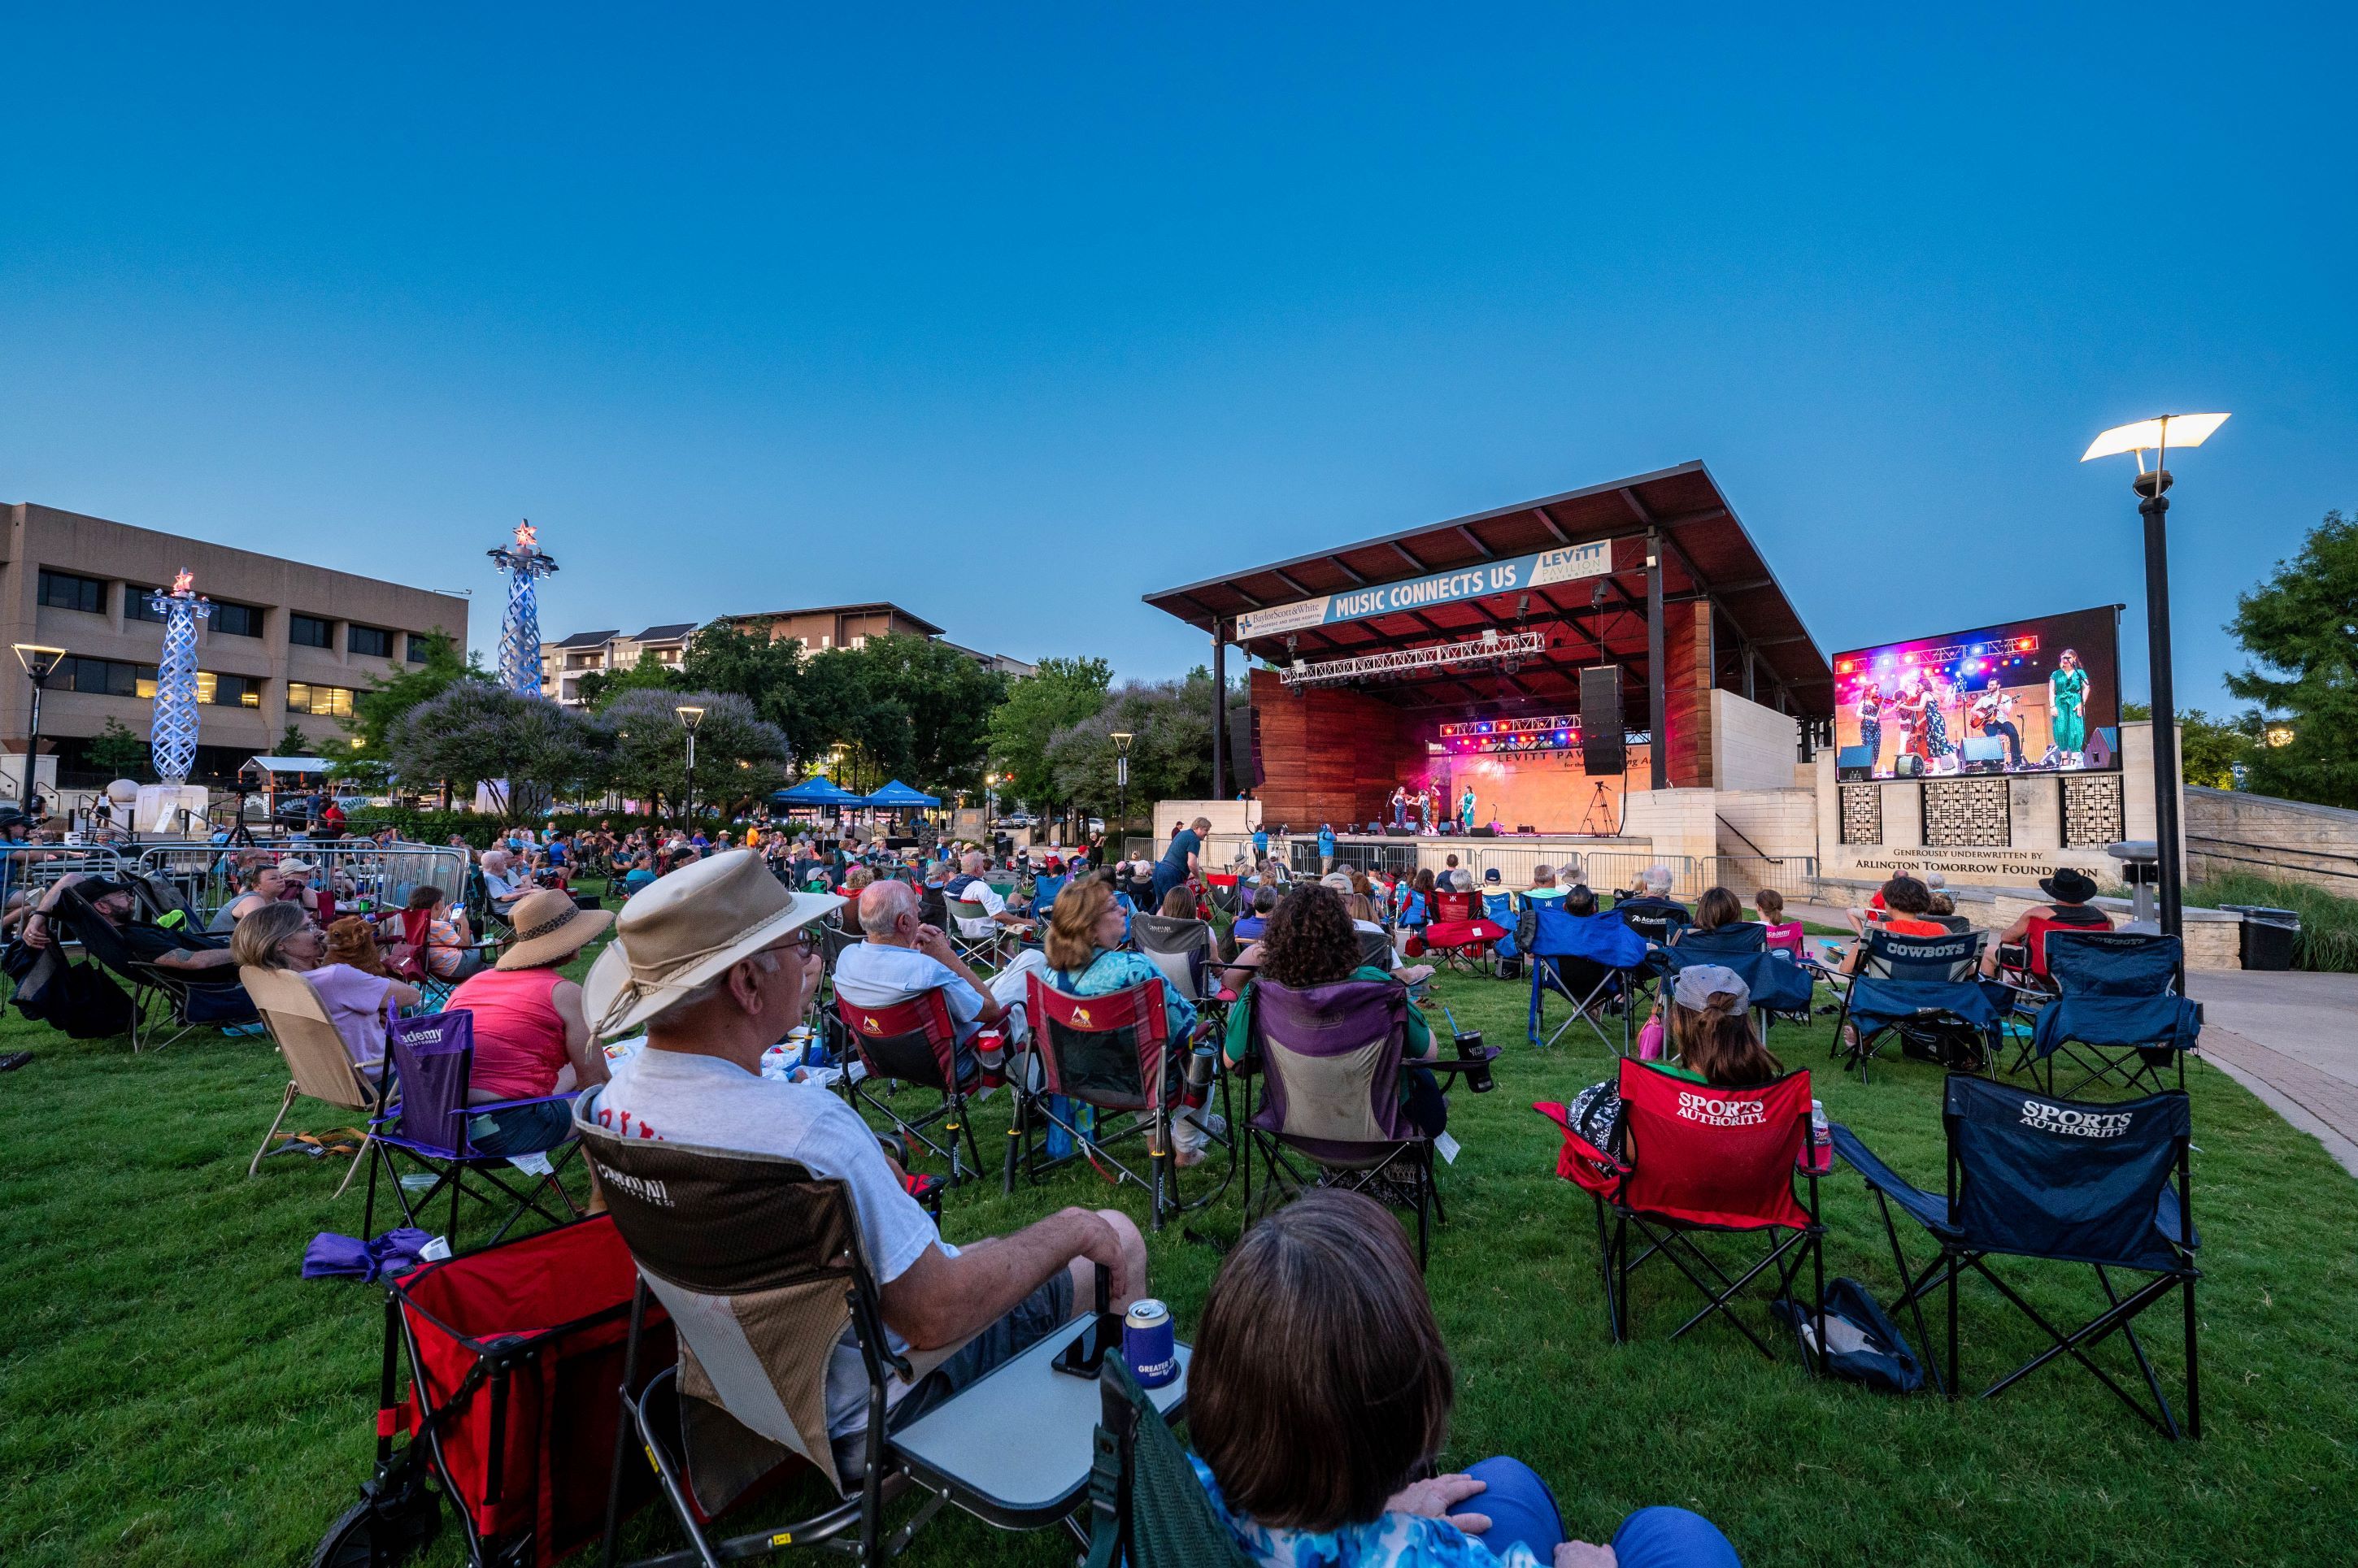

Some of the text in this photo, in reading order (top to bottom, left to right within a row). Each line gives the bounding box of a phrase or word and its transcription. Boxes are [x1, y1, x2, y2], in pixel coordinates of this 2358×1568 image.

[1542, 559, 1600, 576] PAVILION
[1336, 565, 1516, 618] MUSIC CONNECTS US
[1253, 621, 1278, 630] ORTHOPEDIC
[1498, 752, 1548, 762] LEVITT
[1893, 849, 1948, 858] GENEROUSLY
[1951, 850, 2027, 859] UNDERWRITTEN
[1856, 859, 1919, 870] ARLINGTON
[1922, 861, 1998, 873] TOMORROW
[1886, 942, 1965, 958] COWBOYS
[1678, 1092, 1764, 1117] SPORTS
[2021, 1100, 2134, 1129] SPORTS
[1138, 1360, 1168, 1373] GREATER
